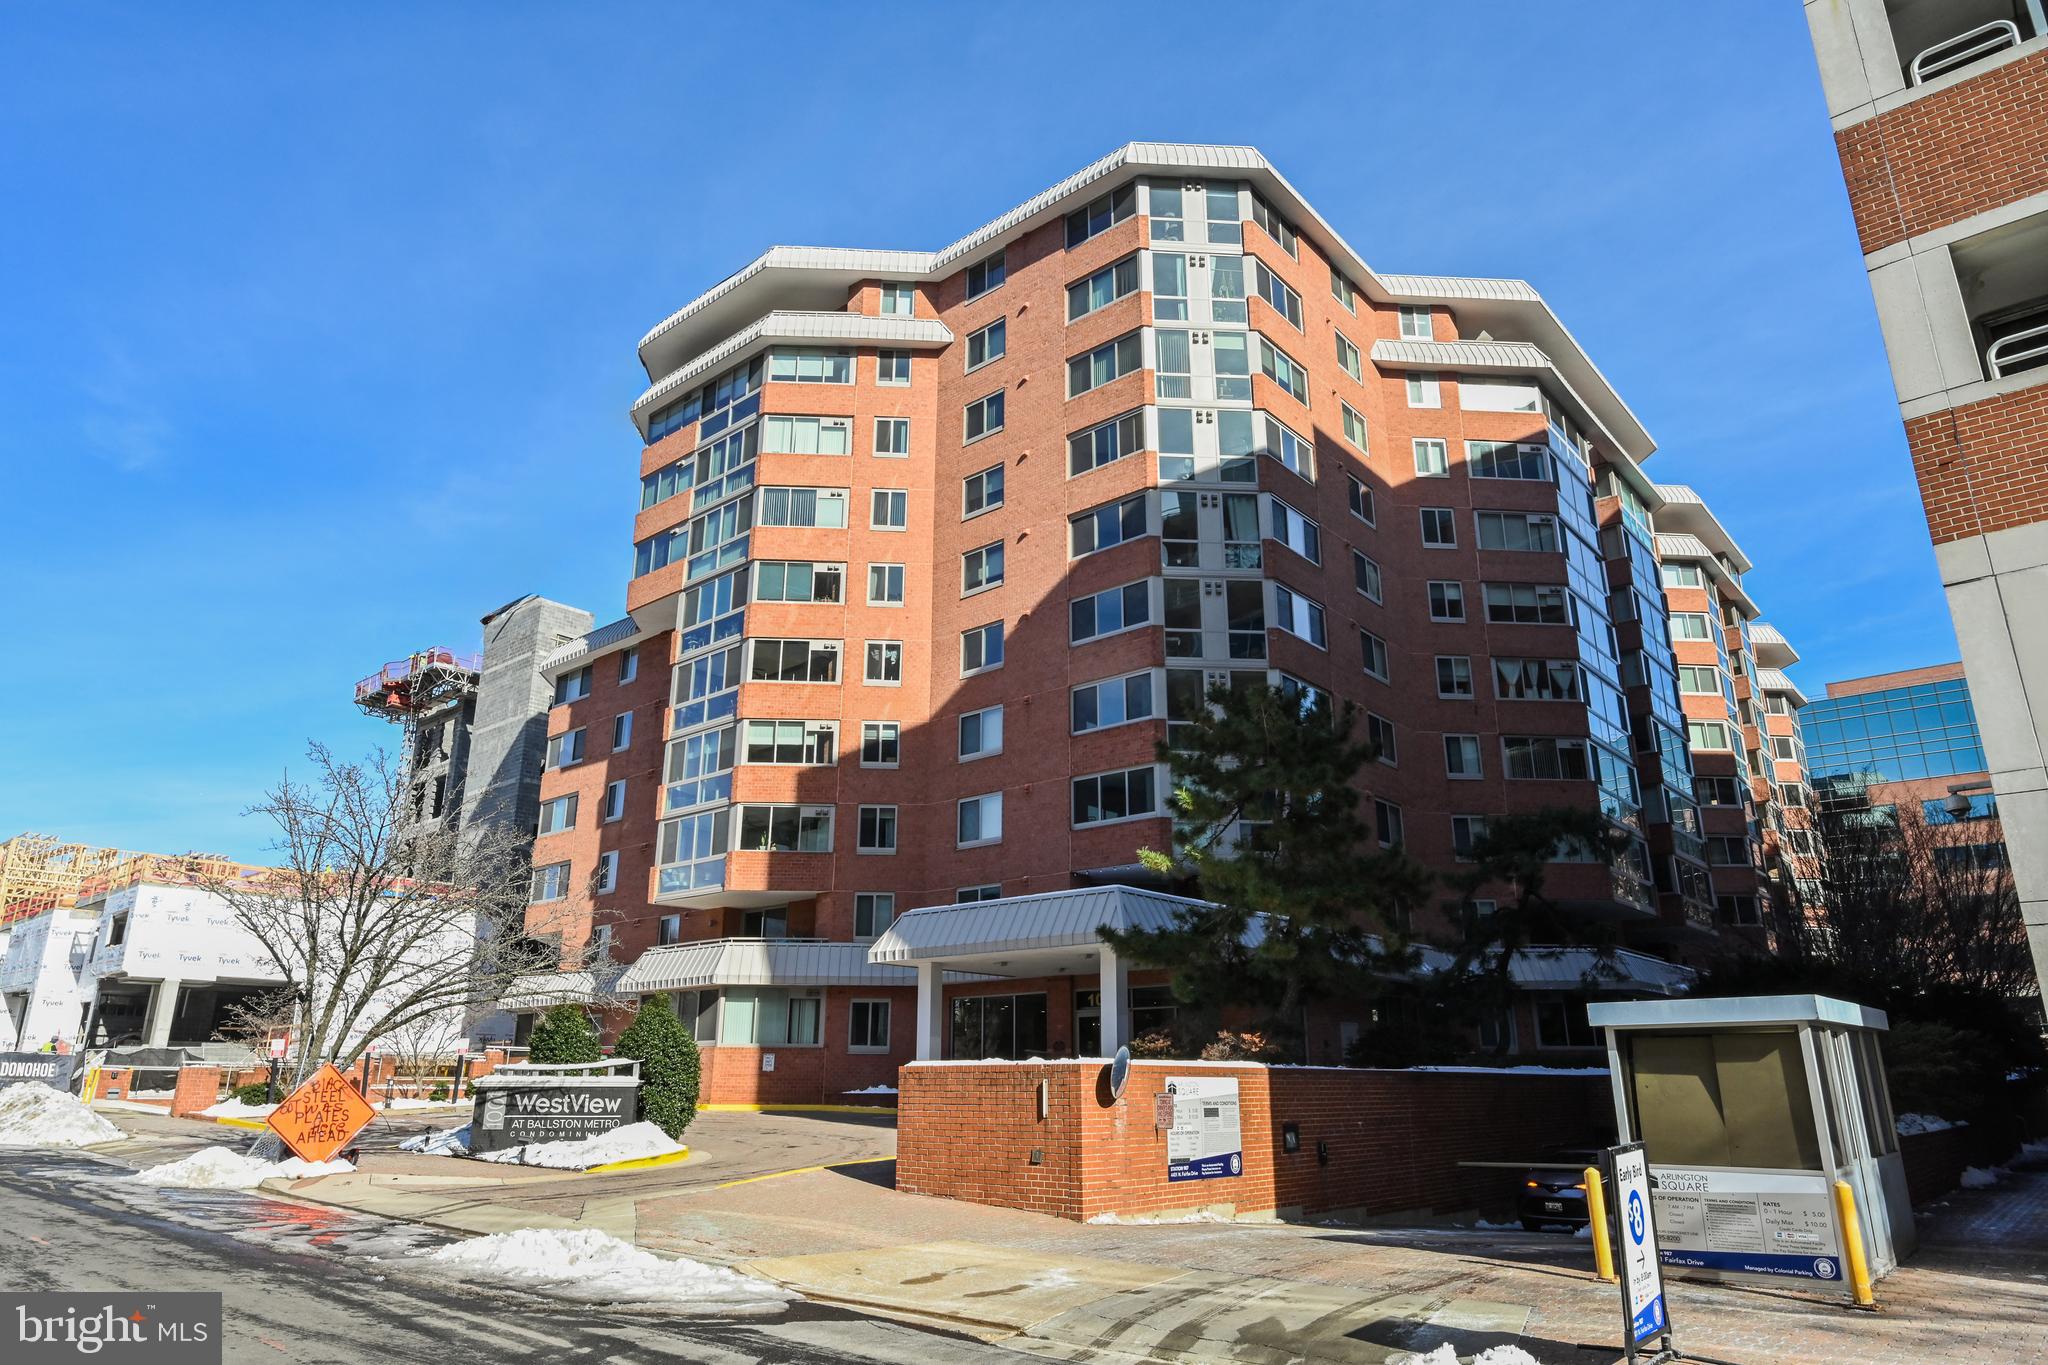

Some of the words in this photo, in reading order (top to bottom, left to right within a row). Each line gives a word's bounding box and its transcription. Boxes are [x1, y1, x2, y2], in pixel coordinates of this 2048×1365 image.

[167, 914, 190, 923] Tyvek
[207, 917, 229, 926] Tyvek
[138, 951, 160, 960] Tyvek
[179, 954, 202, 963] Tyvek
[218, 957, 240, 966] Tyvek
[0, 1061, 56, 1077] DONOHOE
[303, 1090, 347, 1103] STEEL
[515, 1093, 622, 1113] WestView
[295, 1109, 350, 1124] PLATES
[511, 1119, 525, 1129] AT
[527, 1119, 582, 1129] BALLSTON
[584, 1119, 621, 1129] METRO
[296, 1131, 347, 1145] AHEAD
[1619, 1165, 1632, 1183] Early
[1632, 1162, 1643, 1178] Bird
[1661, 1173, 1709, 1182] ARLINGTON
[1661, 1181, 1710, 1193] SQUARE
[1765, 1218, 1780, 1226] Daily
[1664, 1256, 1686, 1265] Fairfax
[1687, 1258, 1705, 1266] Drive
[1744, 1264, 1767, 1272] Managed
[1794, 1269, 1814, 1277] Parking
